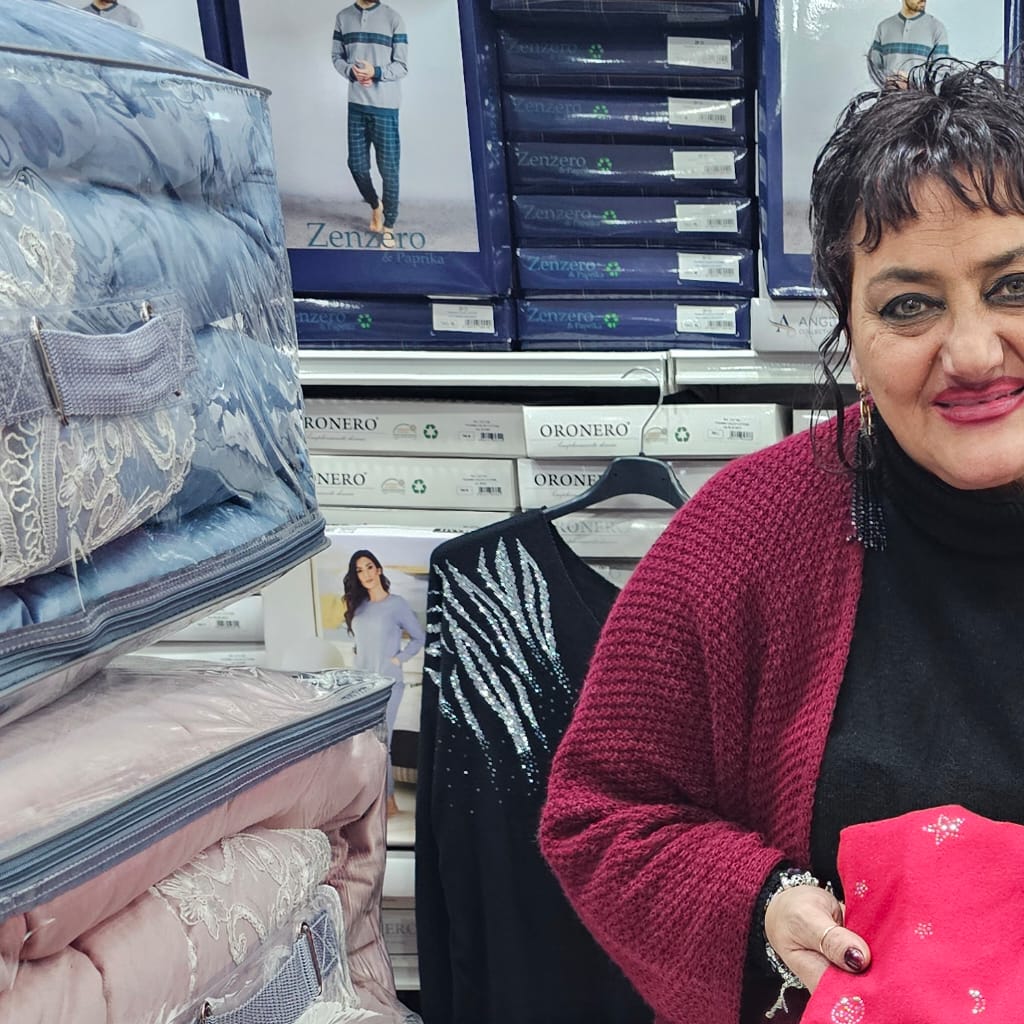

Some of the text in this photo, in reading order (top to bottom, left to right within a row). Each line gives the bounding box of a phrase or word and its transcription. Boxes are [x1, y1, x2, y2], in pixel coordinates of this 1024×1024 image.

[518, 152, 586, 167] Zenzero
[524, 205, 591, 220] Zenzero
[307, 223, 426, 249] Zenzero
[397, 253, 445, 267] Paprika
[528, 256, 595, 271] Zenzero
[527, 307, 594, 322] Zenzero
[304, 417, 377, 430] RONERO
[540, 424, 628, 437] ORONERO
